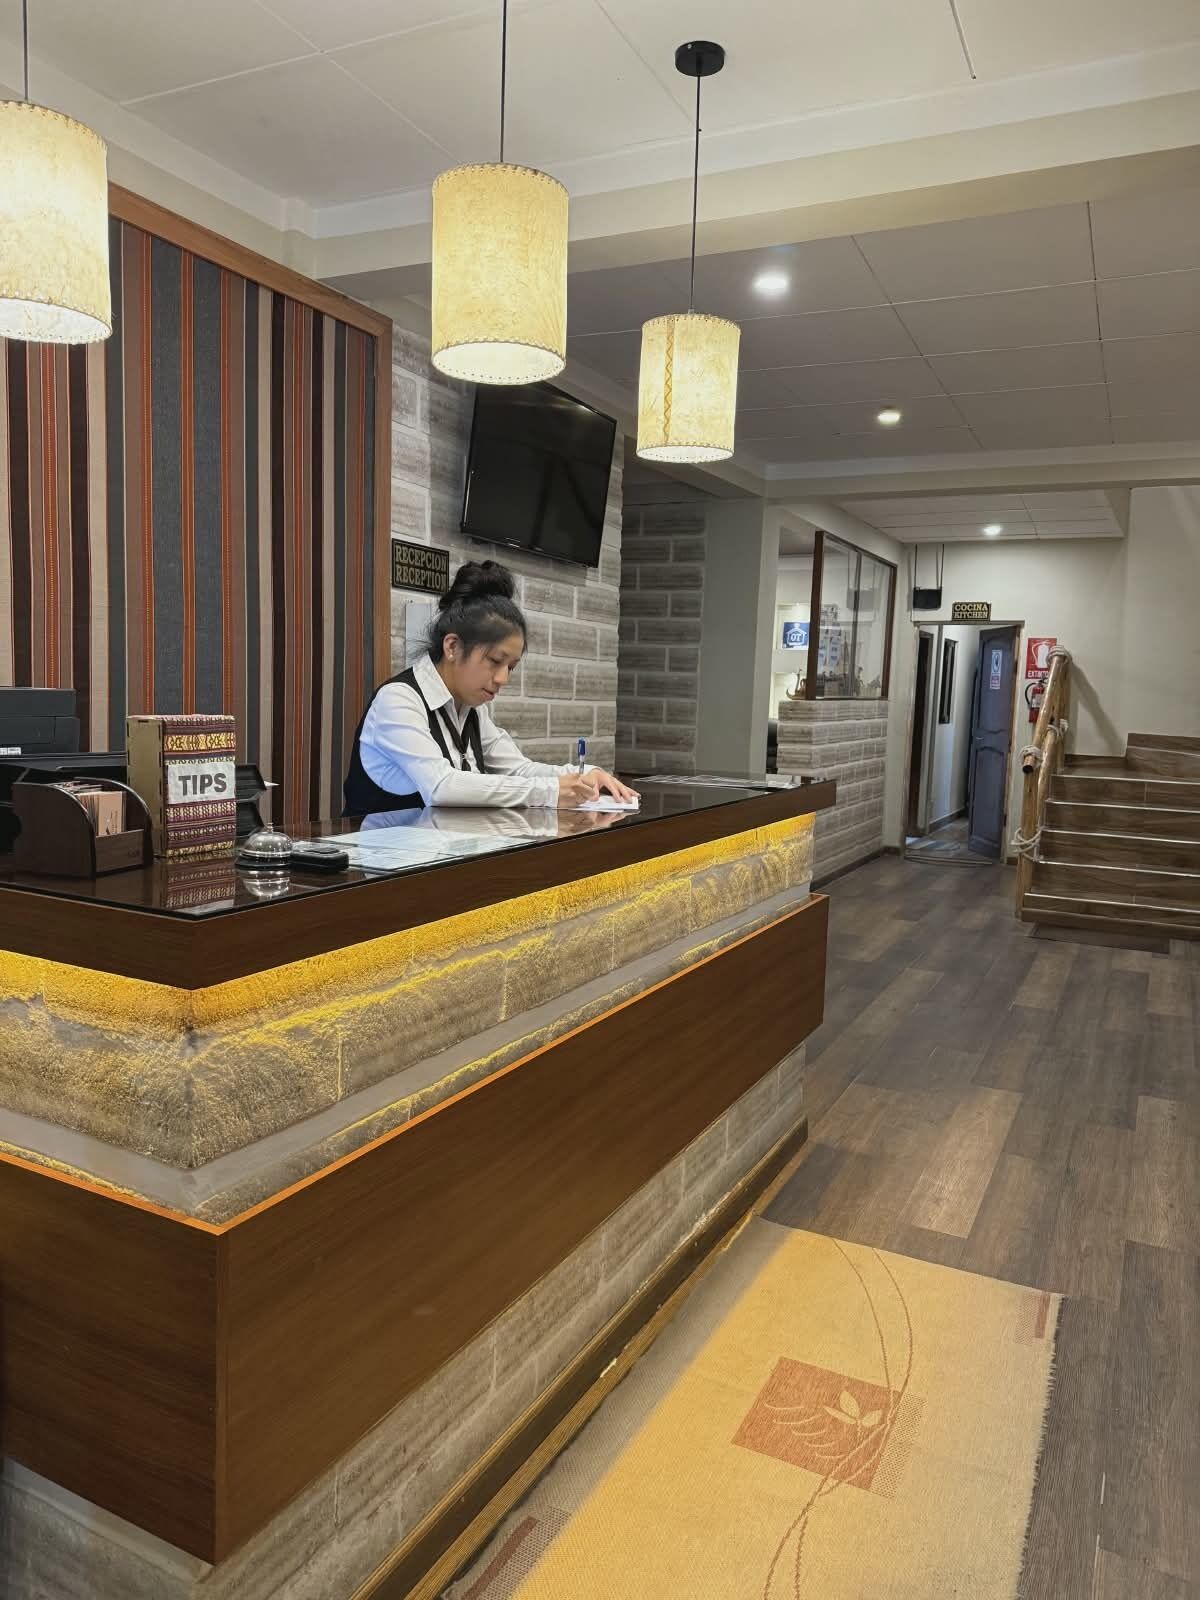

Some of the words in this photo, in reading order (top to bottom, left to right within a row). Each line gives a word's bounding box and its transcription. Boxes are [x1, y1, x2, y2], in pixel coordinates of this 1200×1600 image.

[395, 544, 447, 573] RECEPCION
[395, 564, 447, 592] RECEPTION
[954, 603, 988, 611] COCINA
[954, 611, 988, 619] KITCHEN
[178, 772, 227, 796] TIPS
